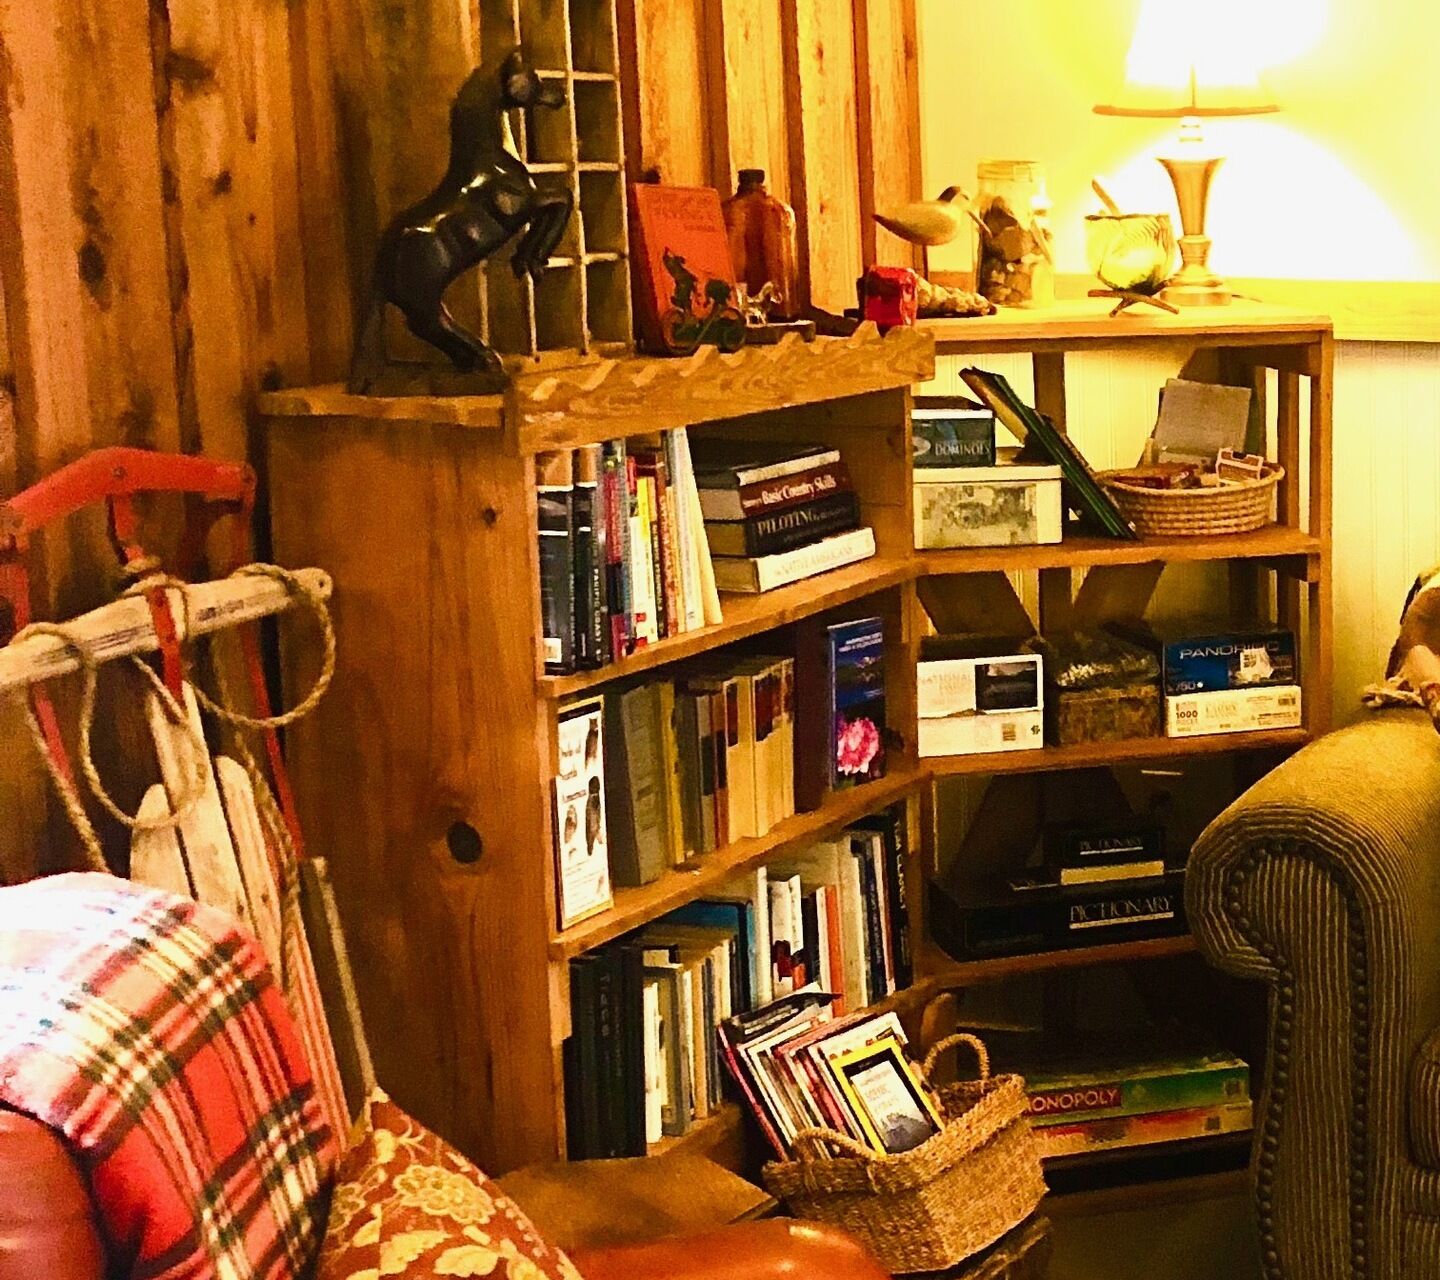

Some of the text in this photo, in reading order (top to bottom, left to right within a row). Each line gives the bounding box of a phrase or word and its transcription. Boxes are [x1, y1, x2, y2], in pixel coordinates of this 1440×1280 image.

[761, 489, 784, 504] Basic
[782, 483, 815, 499] Country
[814, 474, 837, 491] Skills
[1175, 710, 1199, 719] 1000
[1069, 894, 1172, 922] PICTIONARY
